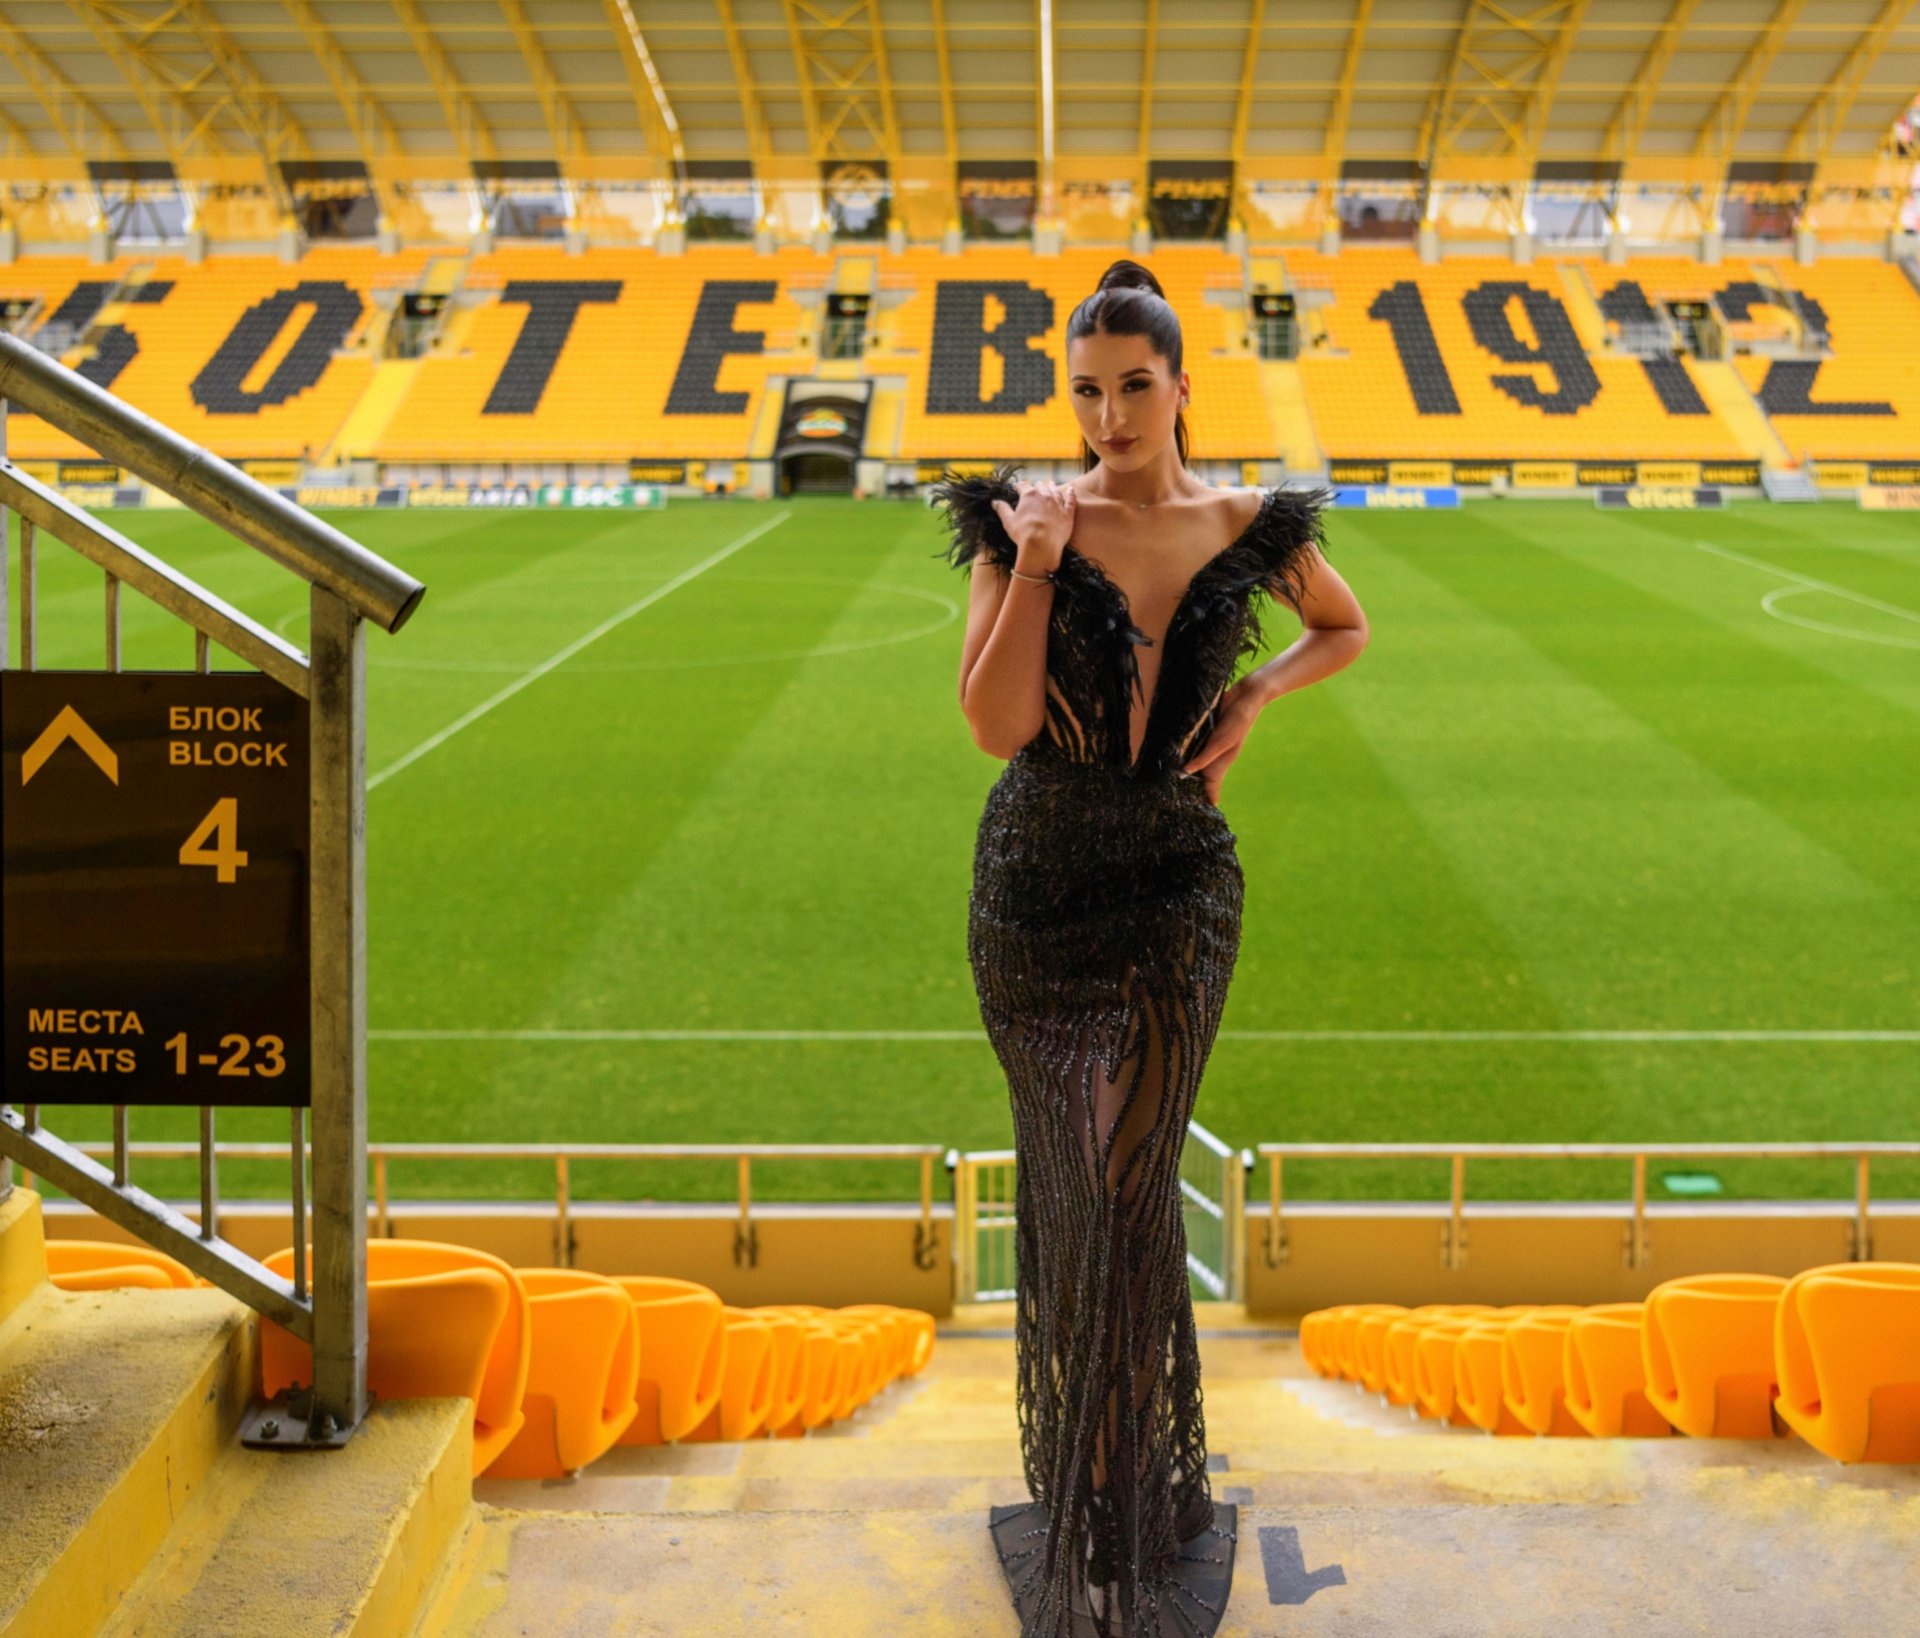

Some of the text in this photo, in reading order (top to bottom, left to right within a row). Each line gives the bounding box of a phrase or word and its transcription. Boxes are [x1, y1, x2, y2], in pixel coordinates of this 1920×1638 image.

[1369, 280, 1896, 414] 1912
[1393, 470, 1445, 480] WINBET
[1518, 470, 1570, 480] WINBET
[169, 706, 262, 732] БЛОК
[169, 740, 288, 768] BLOCK
[179, 797, 249, 884] 4
[28, 1008, 145, 1036] МЕСТА
[28, 1047, 137, 1074] SEATS
[165, 1032, 287, 1078] 1-23
